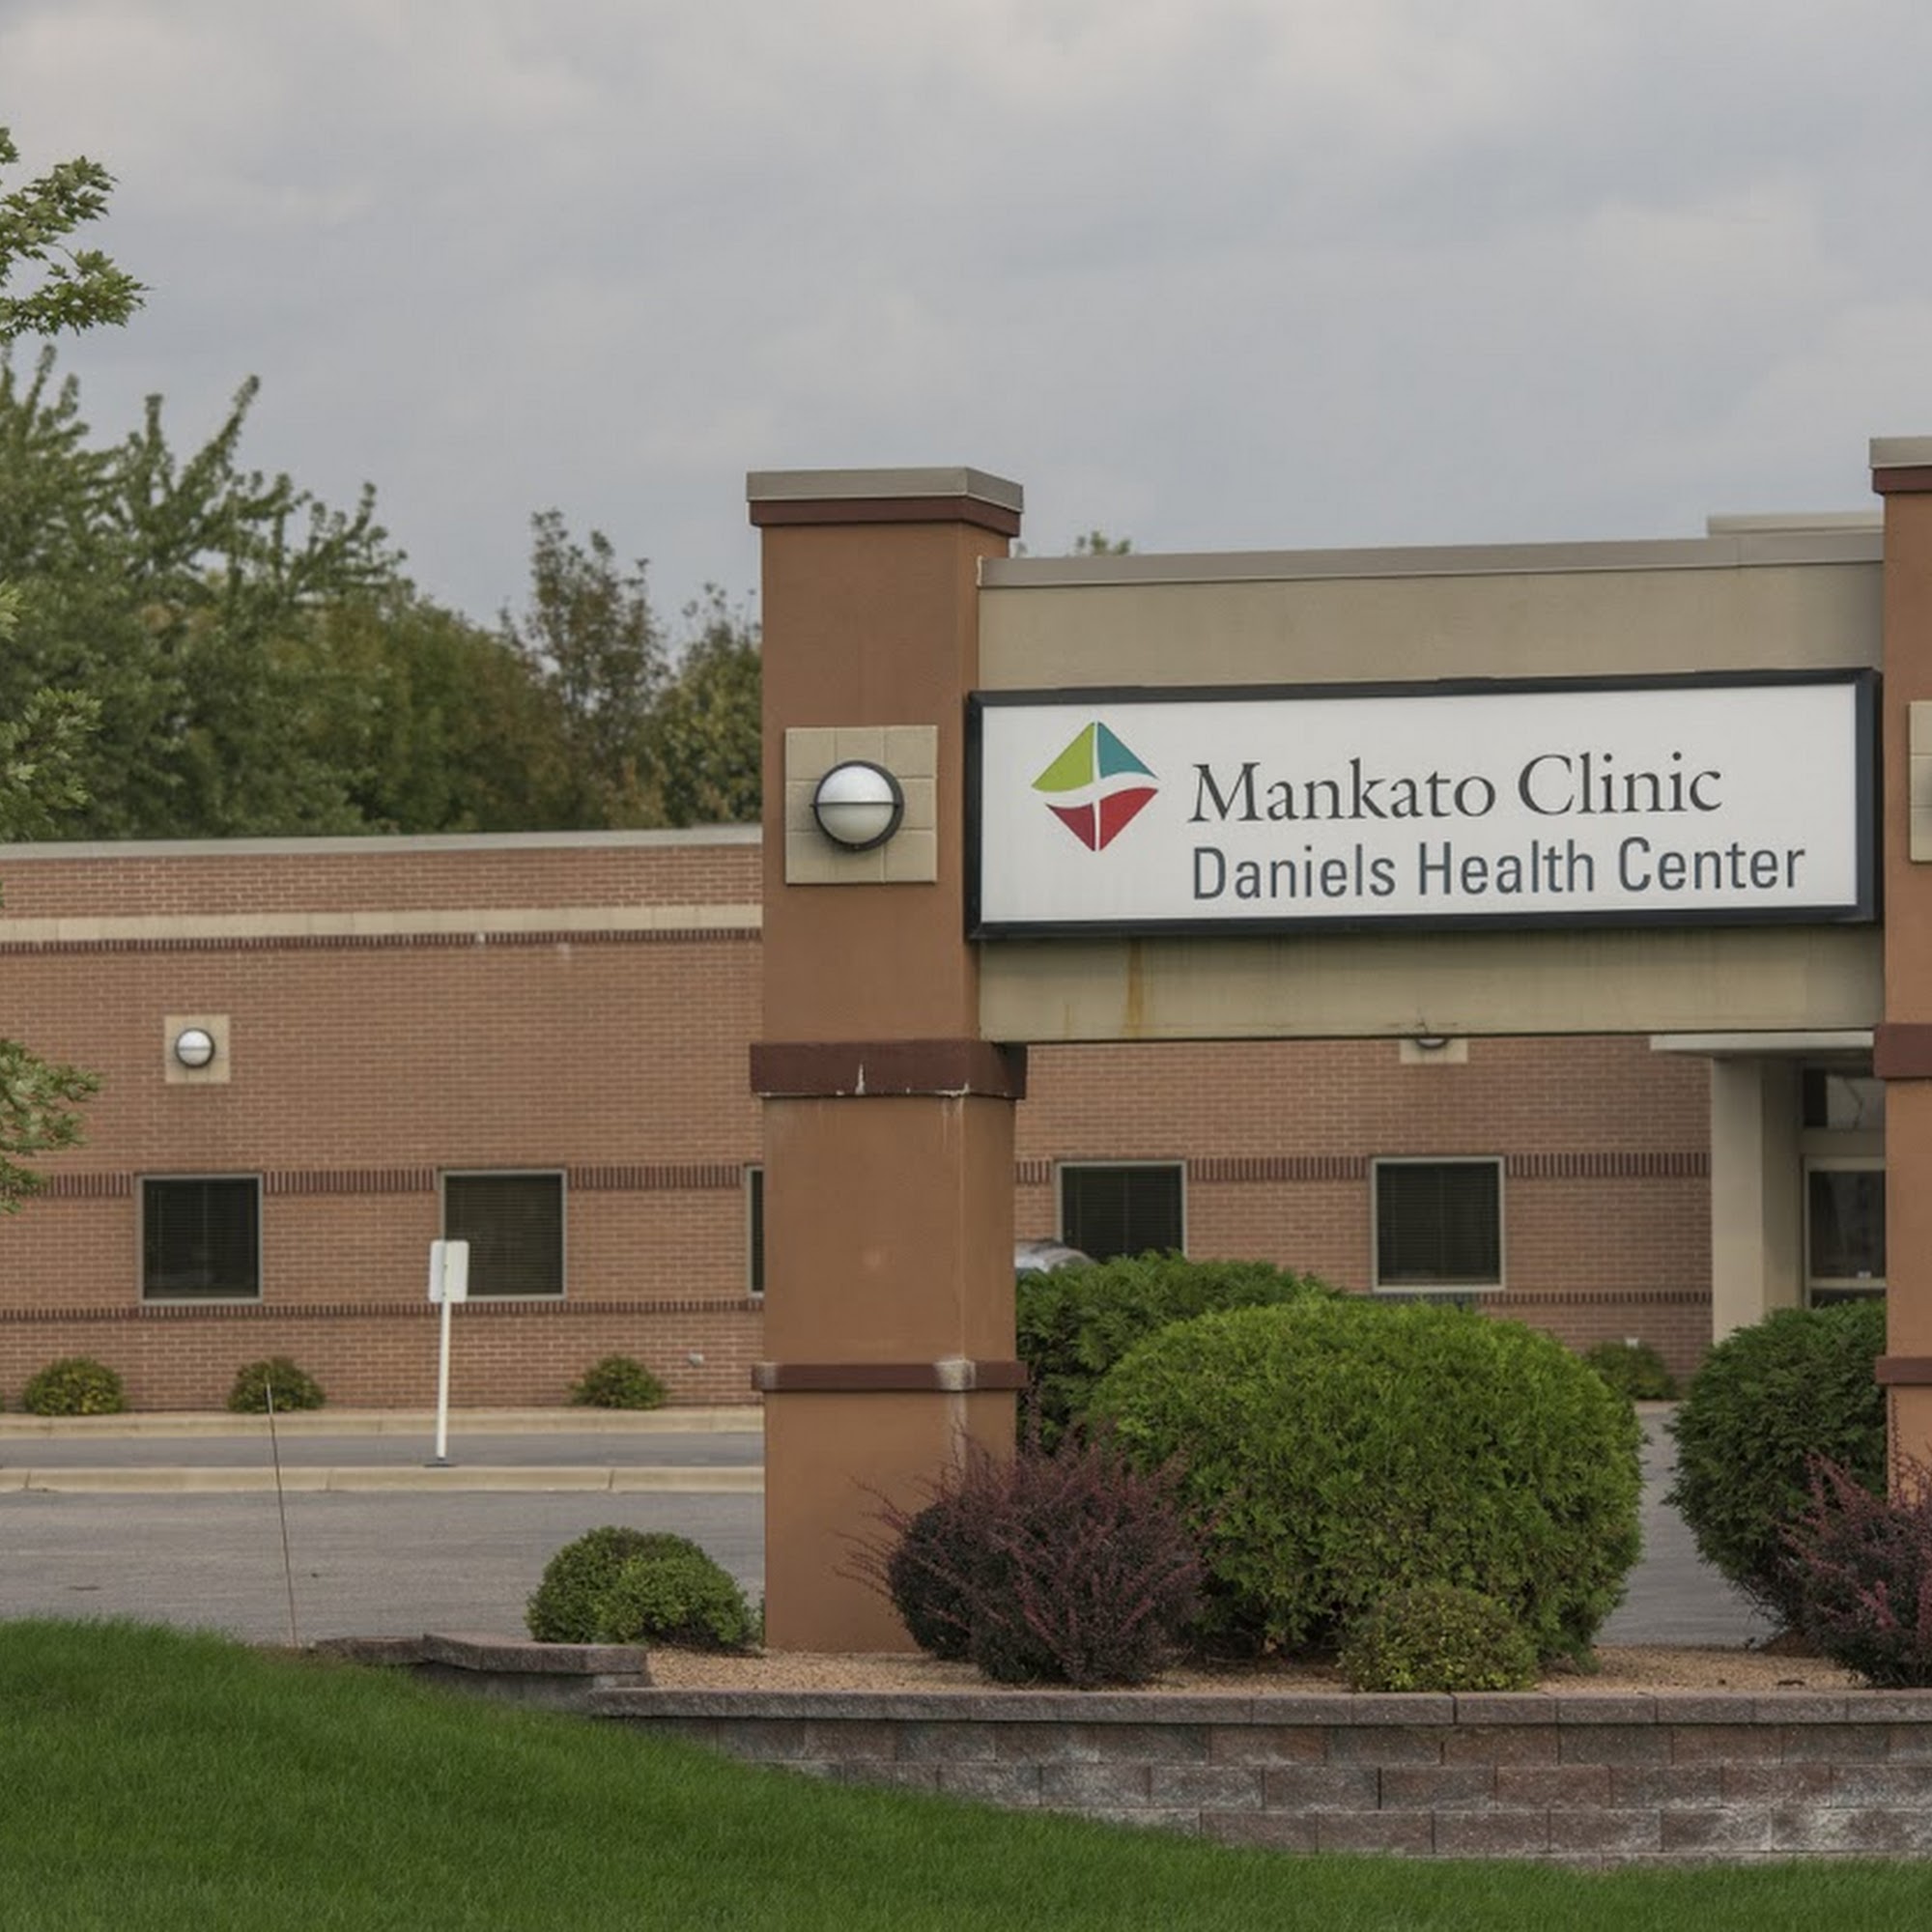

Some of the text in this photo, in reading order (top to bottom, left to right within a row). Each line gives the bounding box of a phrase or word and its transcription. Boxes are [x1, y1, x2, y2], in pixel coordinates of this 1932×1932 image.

[1187, 751, 1721, 823] Mankato Clinic
[1193, 836, 1805, 900] Daniels Health Center
